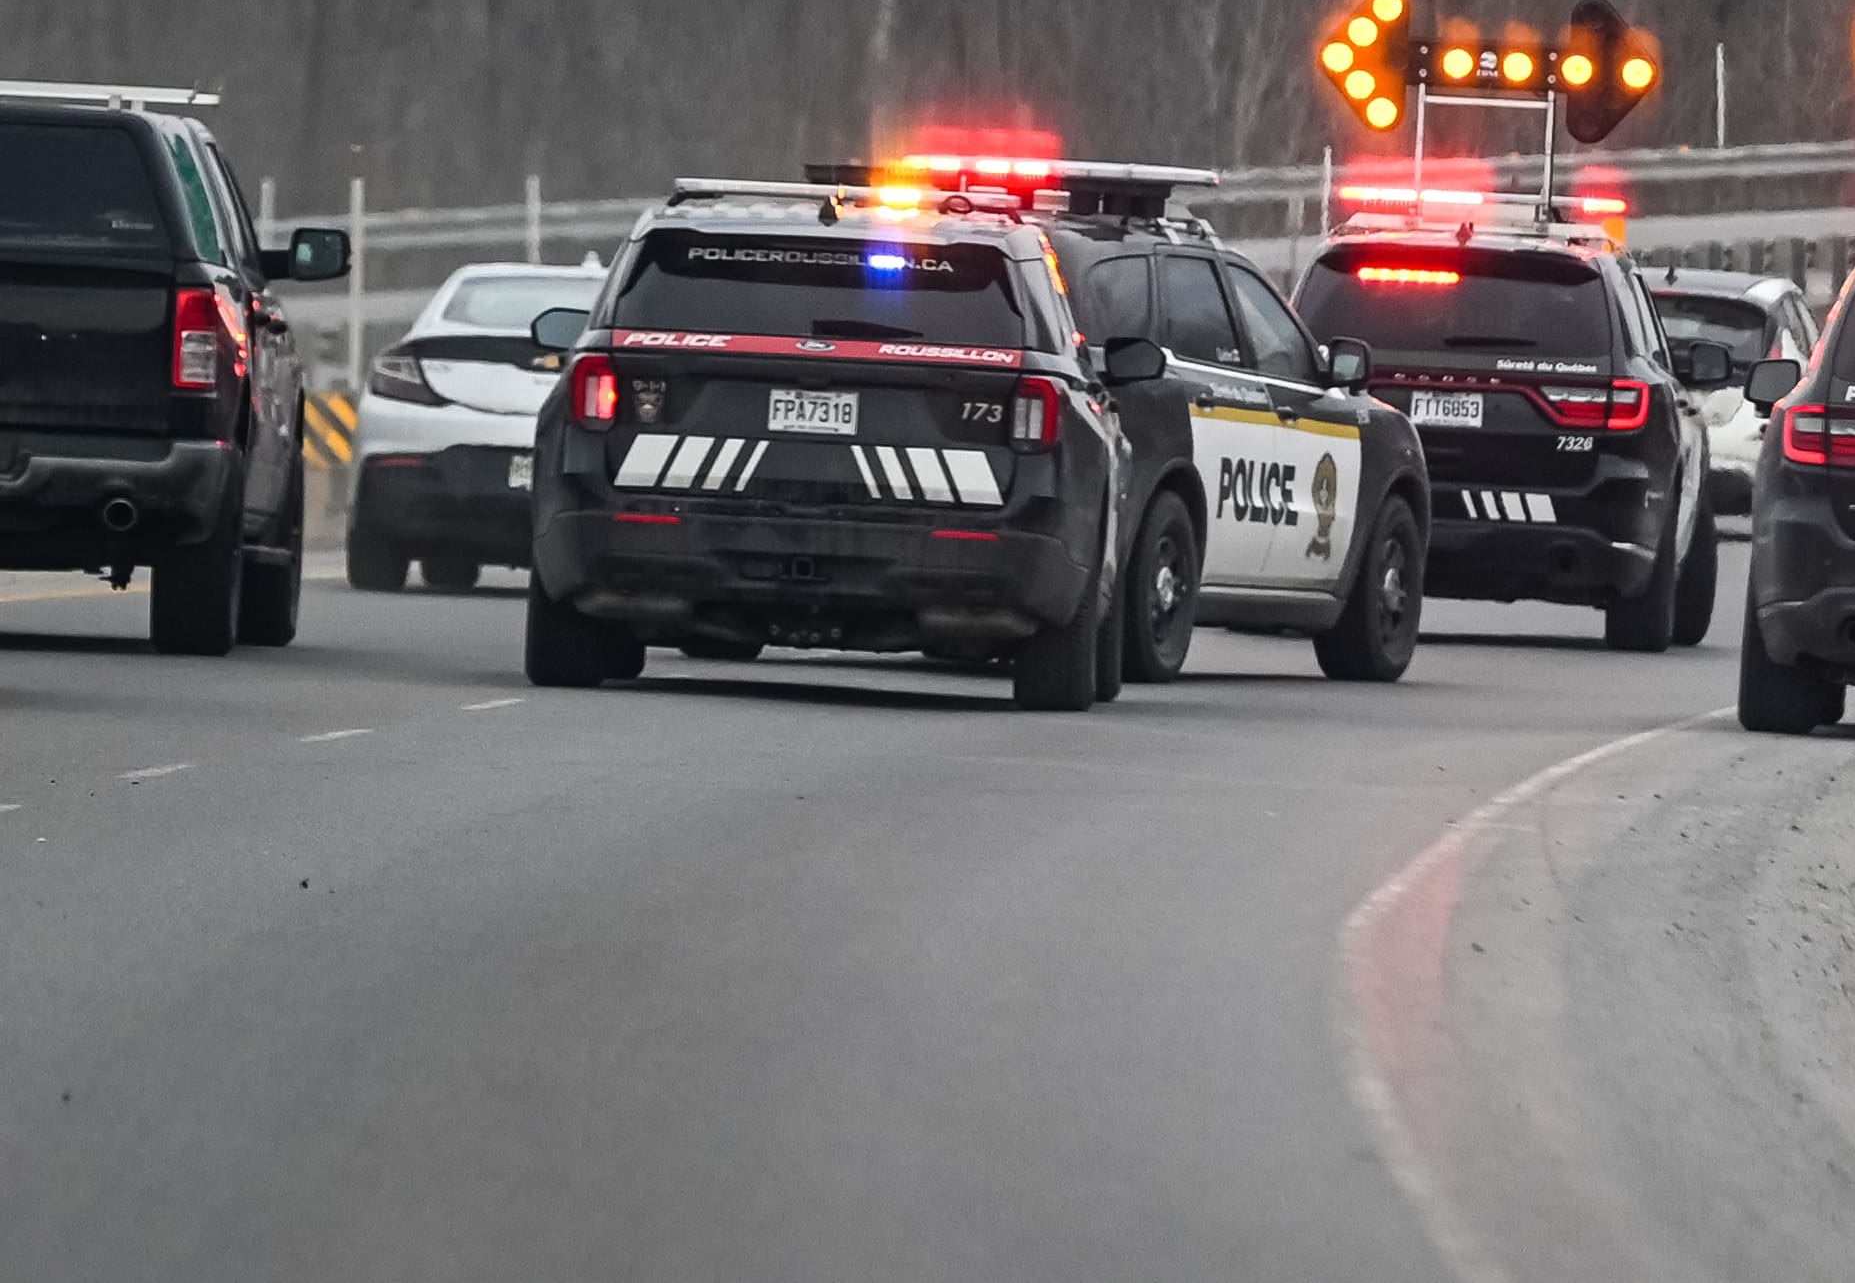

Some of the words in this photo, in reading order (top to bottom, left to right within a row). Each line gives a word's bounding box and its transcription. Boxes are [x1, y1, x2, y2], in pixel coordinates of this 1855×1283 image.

[623, 333, 732, 348] POLICE
[878, 344, 1015, 364] ROUSSILLON
[772, 399, 853, 425] FPA7318
[960, 402, 1003, 423] 173
[1216, 456, 1299, 526] POLICE
